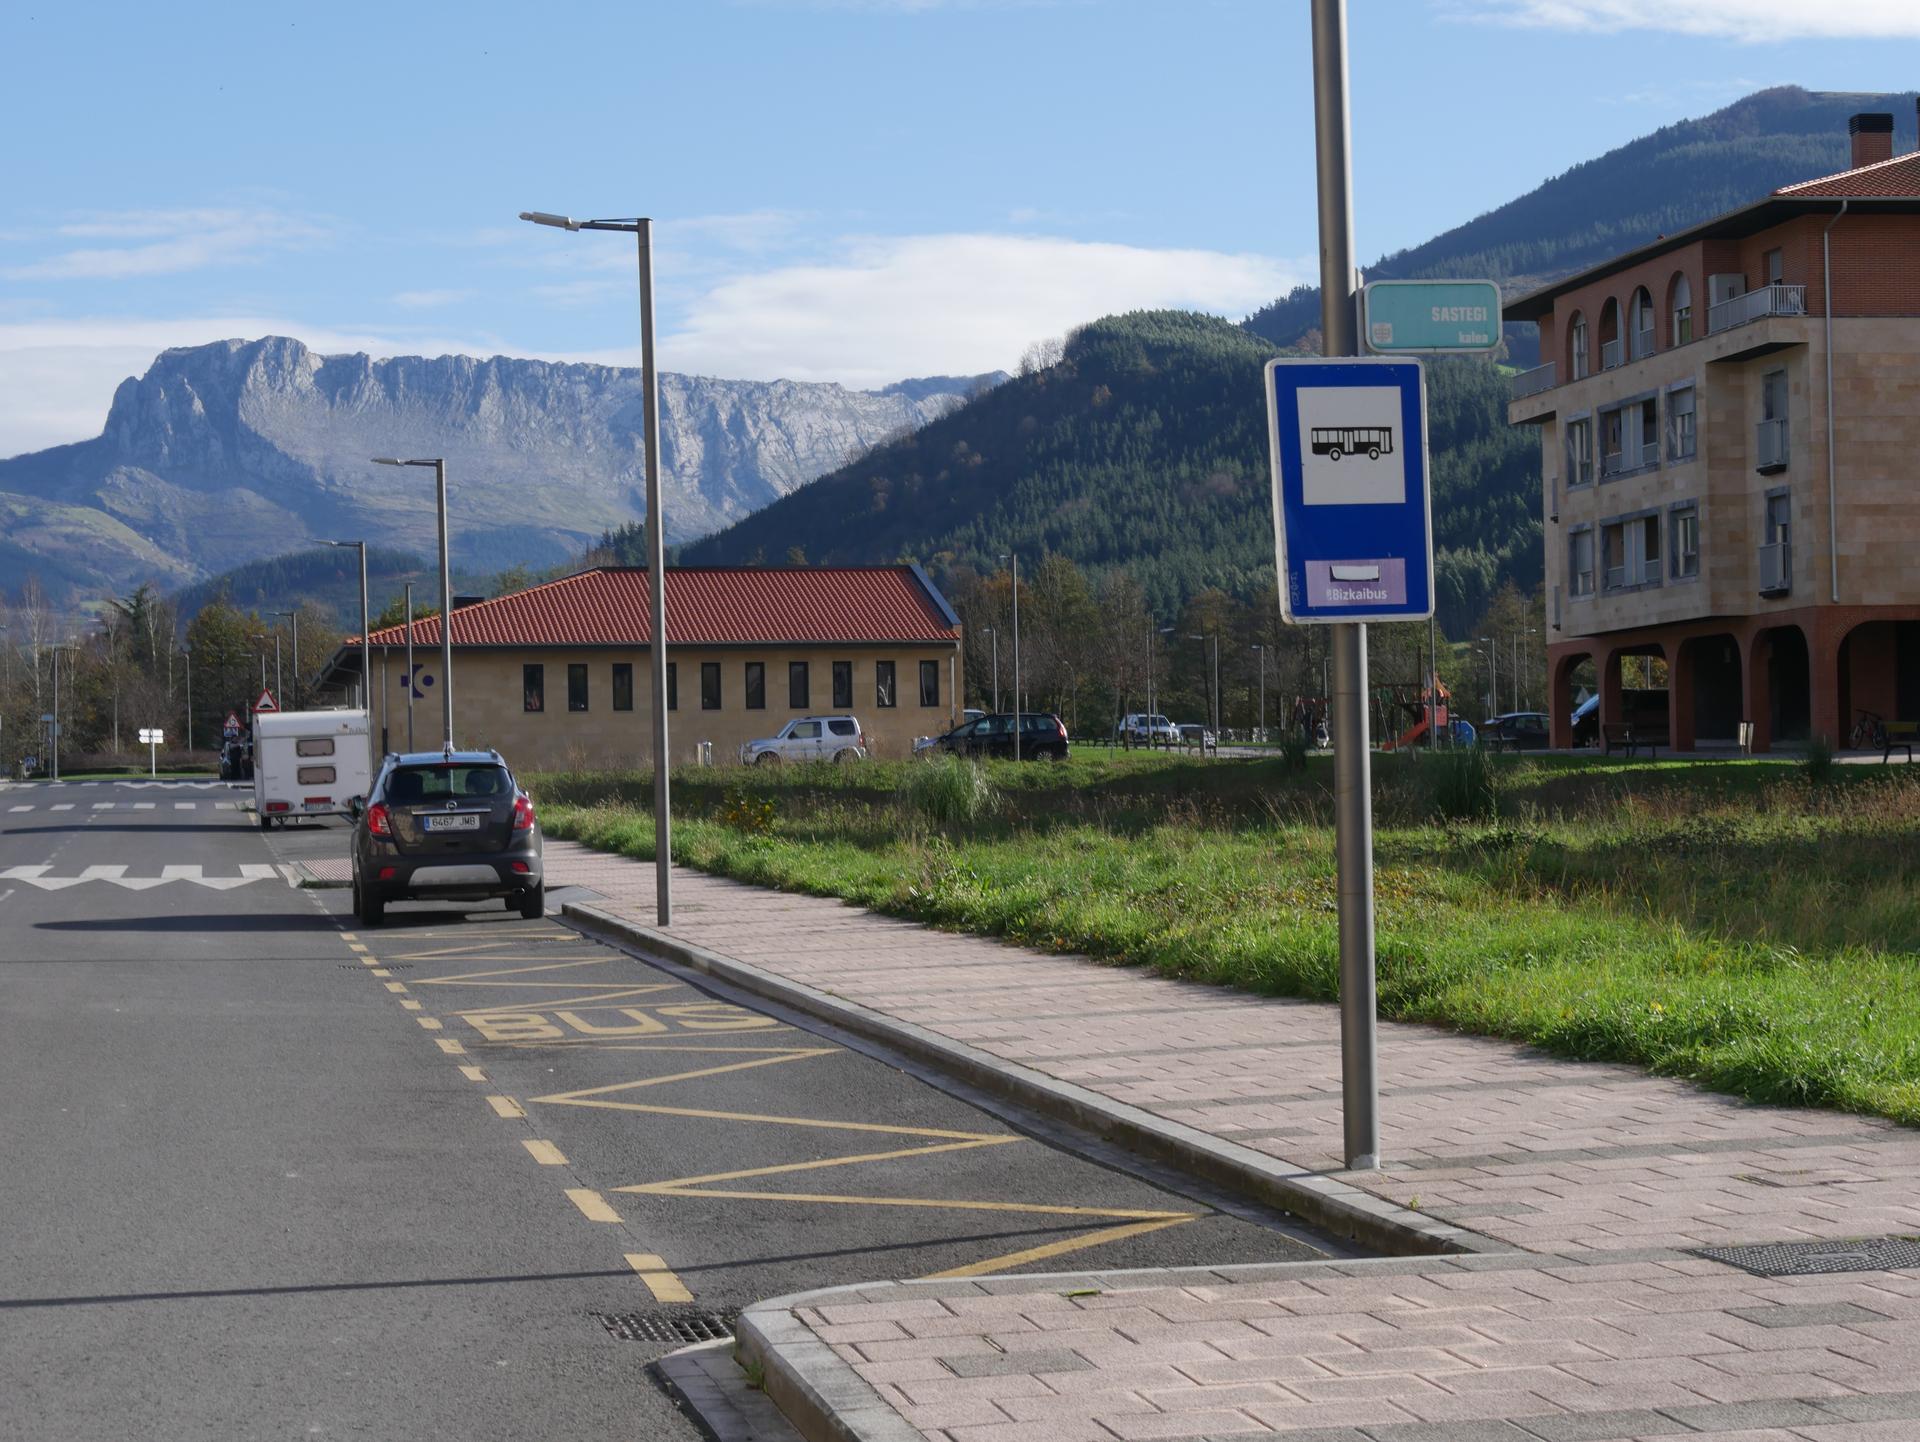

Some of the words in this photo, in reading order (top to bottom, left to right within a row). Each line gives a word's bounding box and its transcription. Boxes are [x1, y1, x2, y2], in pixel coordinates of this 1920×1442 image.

[1431, 306, 1488, 321] SASTEGI
[1458, 331, 1489, 344] kalea
[1332, 587, 1388, 601] Bizkaibus
[461, 1004, 780, 1041] BUS
